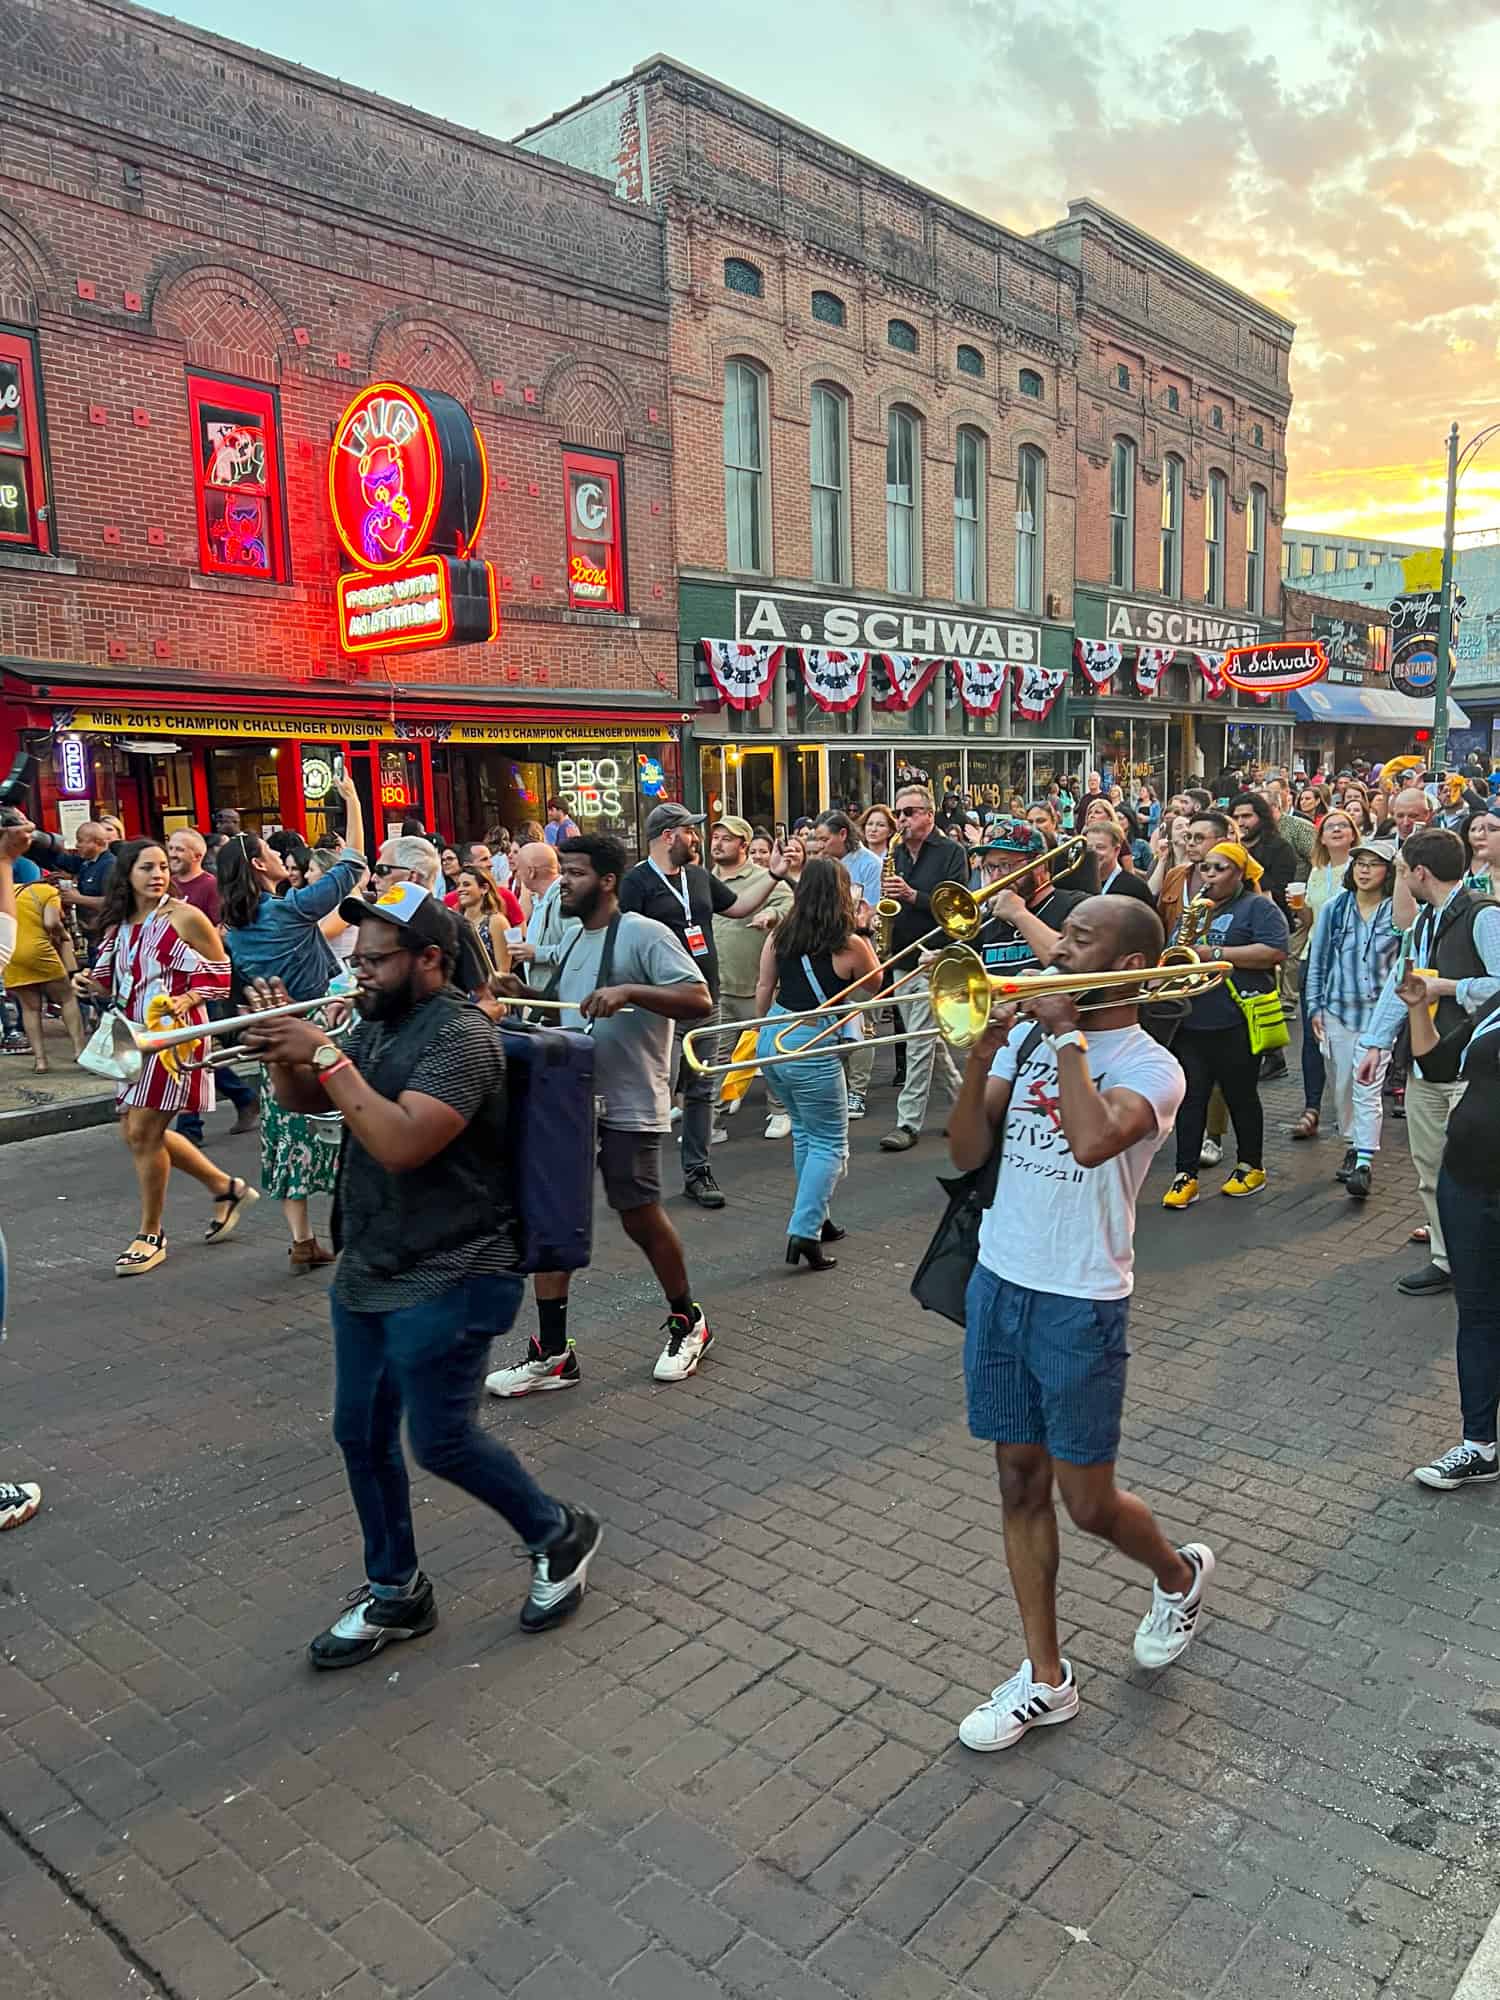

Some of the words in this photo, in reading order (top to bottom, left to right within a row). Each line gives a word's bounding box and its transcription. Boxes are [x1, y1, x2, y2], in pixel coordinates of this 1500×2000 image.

[339, 398, 418, 457] PIG
[571, 557, 608, 584] Coors
[394, 573, 438, 600] WITH
[824, 608, 1034, 661] SCHWAB
[1248, 648, 1319, 673] Schwab
[91, 712, 122, 726] MBN
[128, 714, 161, 728] 2013
[165, 716, 239, 730] CHAMPION
[243, 719, 328, 734] CHALLENGER
[331, 723, 384, 736] DIVISION
[462, 727, 484, 738] MBN
[487, 727, 510, 738] 2013
[513, 727, 562, 738] CHAMPION
[565, 727, 622, 738] CHALLENGER
[624, 727, 661, 738] DIVISION
[66, 743, 82, 788] OPEN
[557, 758, 619, 788] BBQ
[559, 789, 621, 816] RIBS
